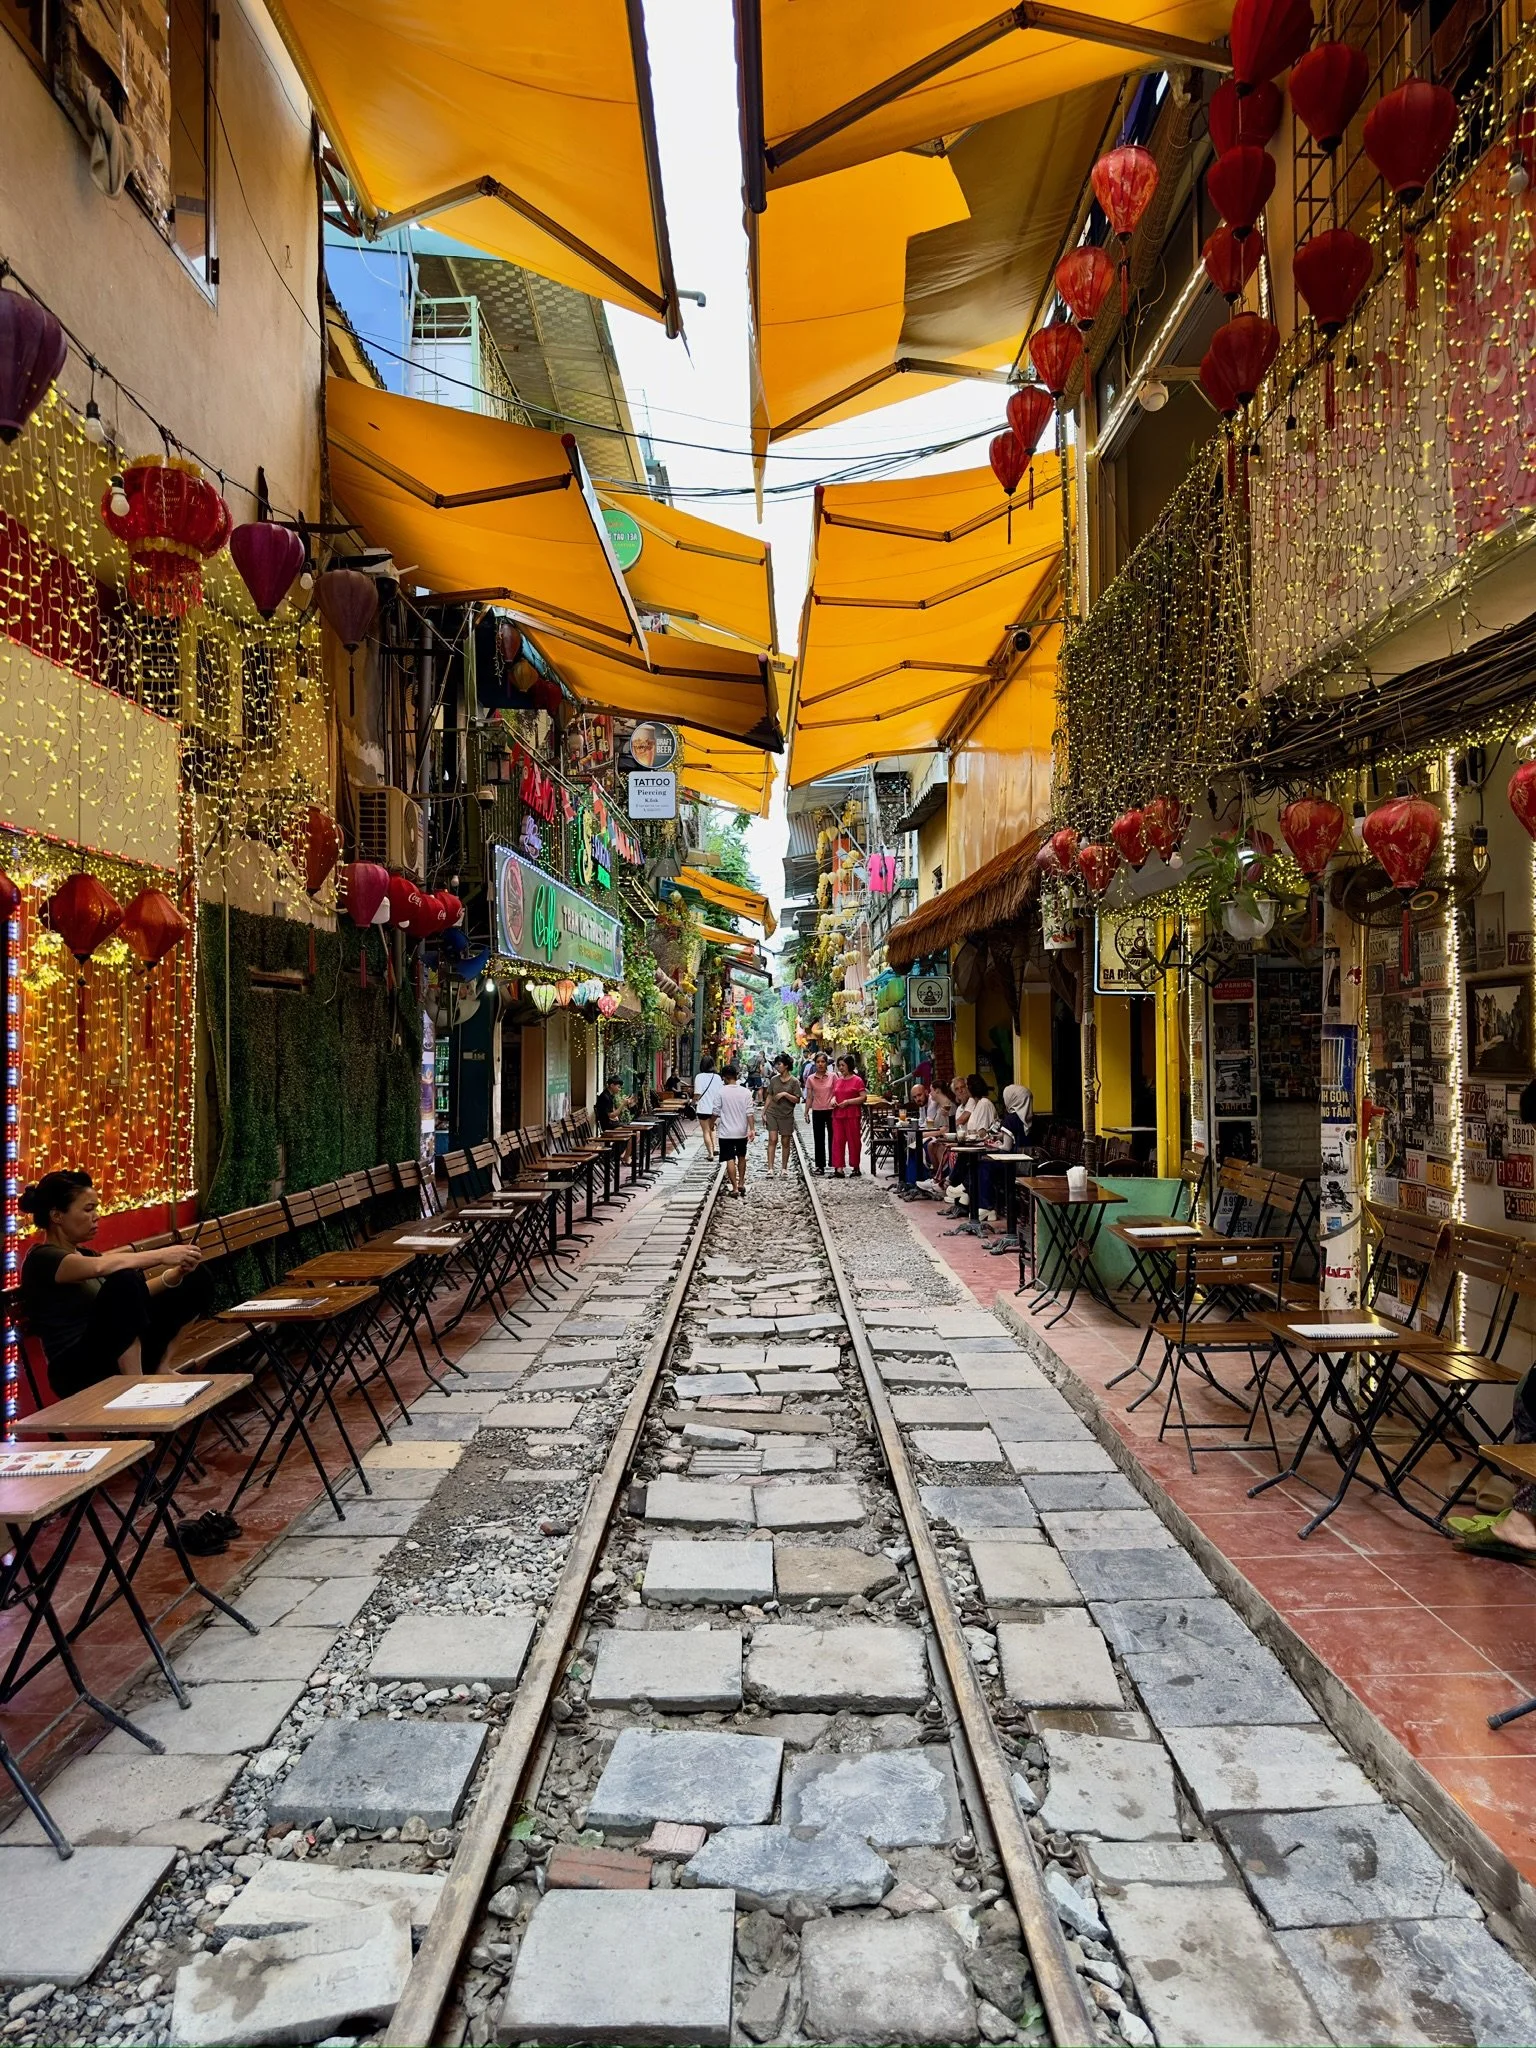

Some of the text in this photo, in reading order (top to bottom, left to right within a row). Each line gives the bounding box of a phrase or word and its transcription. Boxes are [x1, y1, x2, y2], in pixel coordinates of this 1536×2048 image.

[656, 738, 672, 746] DRAFT
[656, 746, 672, 754] BEER
[633, 778, 671, 786] TATTOO
[637, 789, 667, 797] Piercing
[1103, 968, 1115, 980] GA
[1224, 981, 1253, 989] PARKING
[1220, 1102, 1252, 1111] SAMPLE
[1516, 1161, 1532, 1183] 1929
